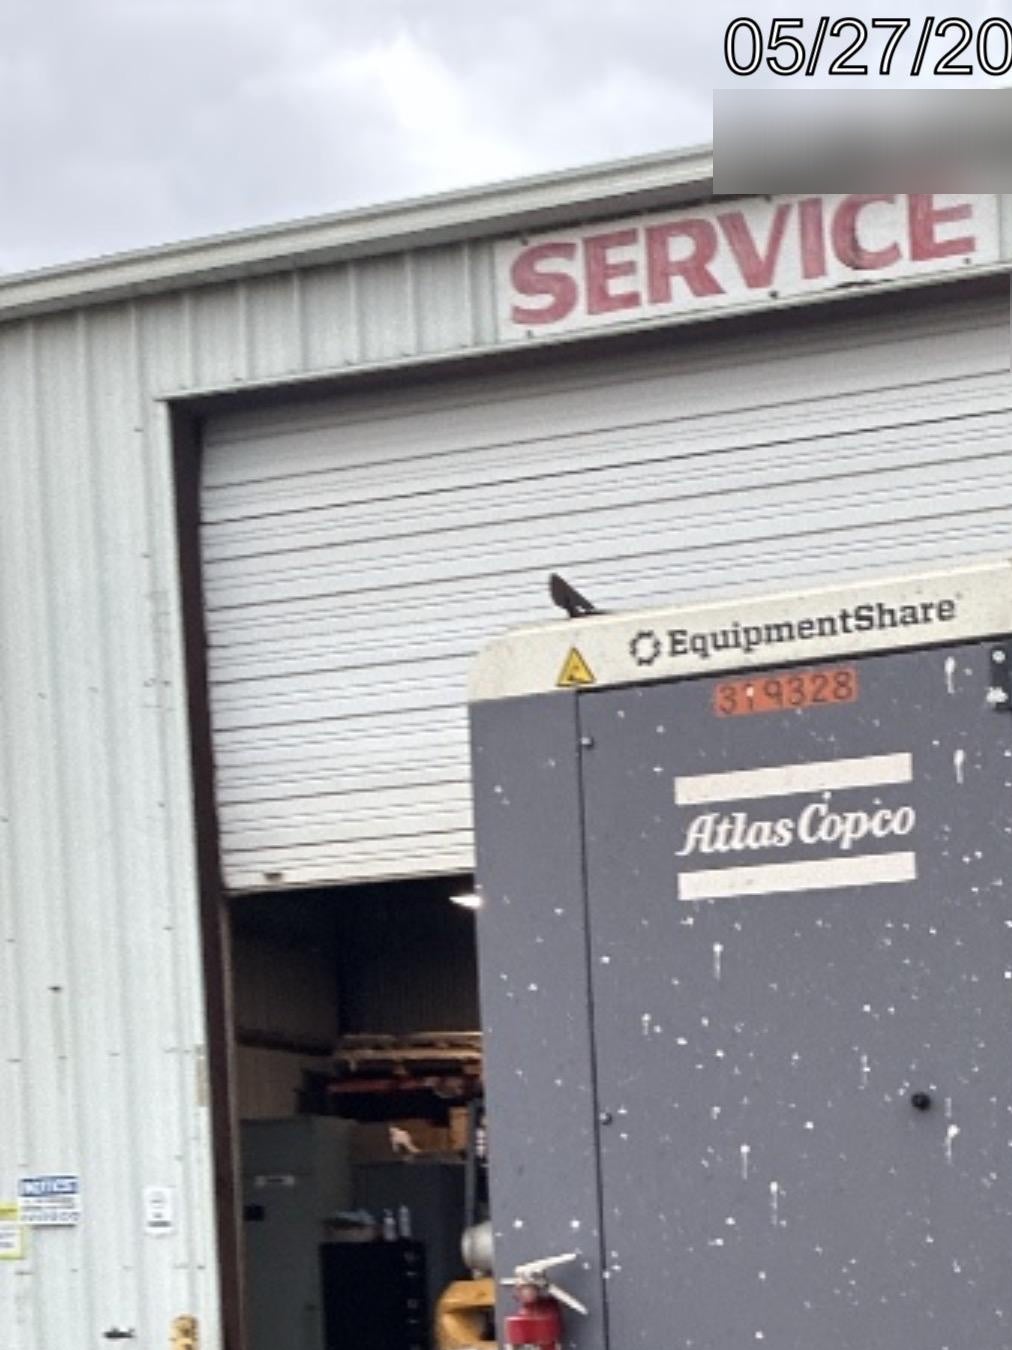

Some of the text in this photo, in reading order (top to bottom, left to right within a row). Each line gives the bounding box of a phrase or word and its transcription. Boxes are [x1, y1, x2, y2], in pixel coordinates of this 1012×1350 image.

[509, 194, 976, 325] SERVICE
[668, 599, 957, 659] EquipmentShare
[675, 803, 916, 856] Atlas Copco
